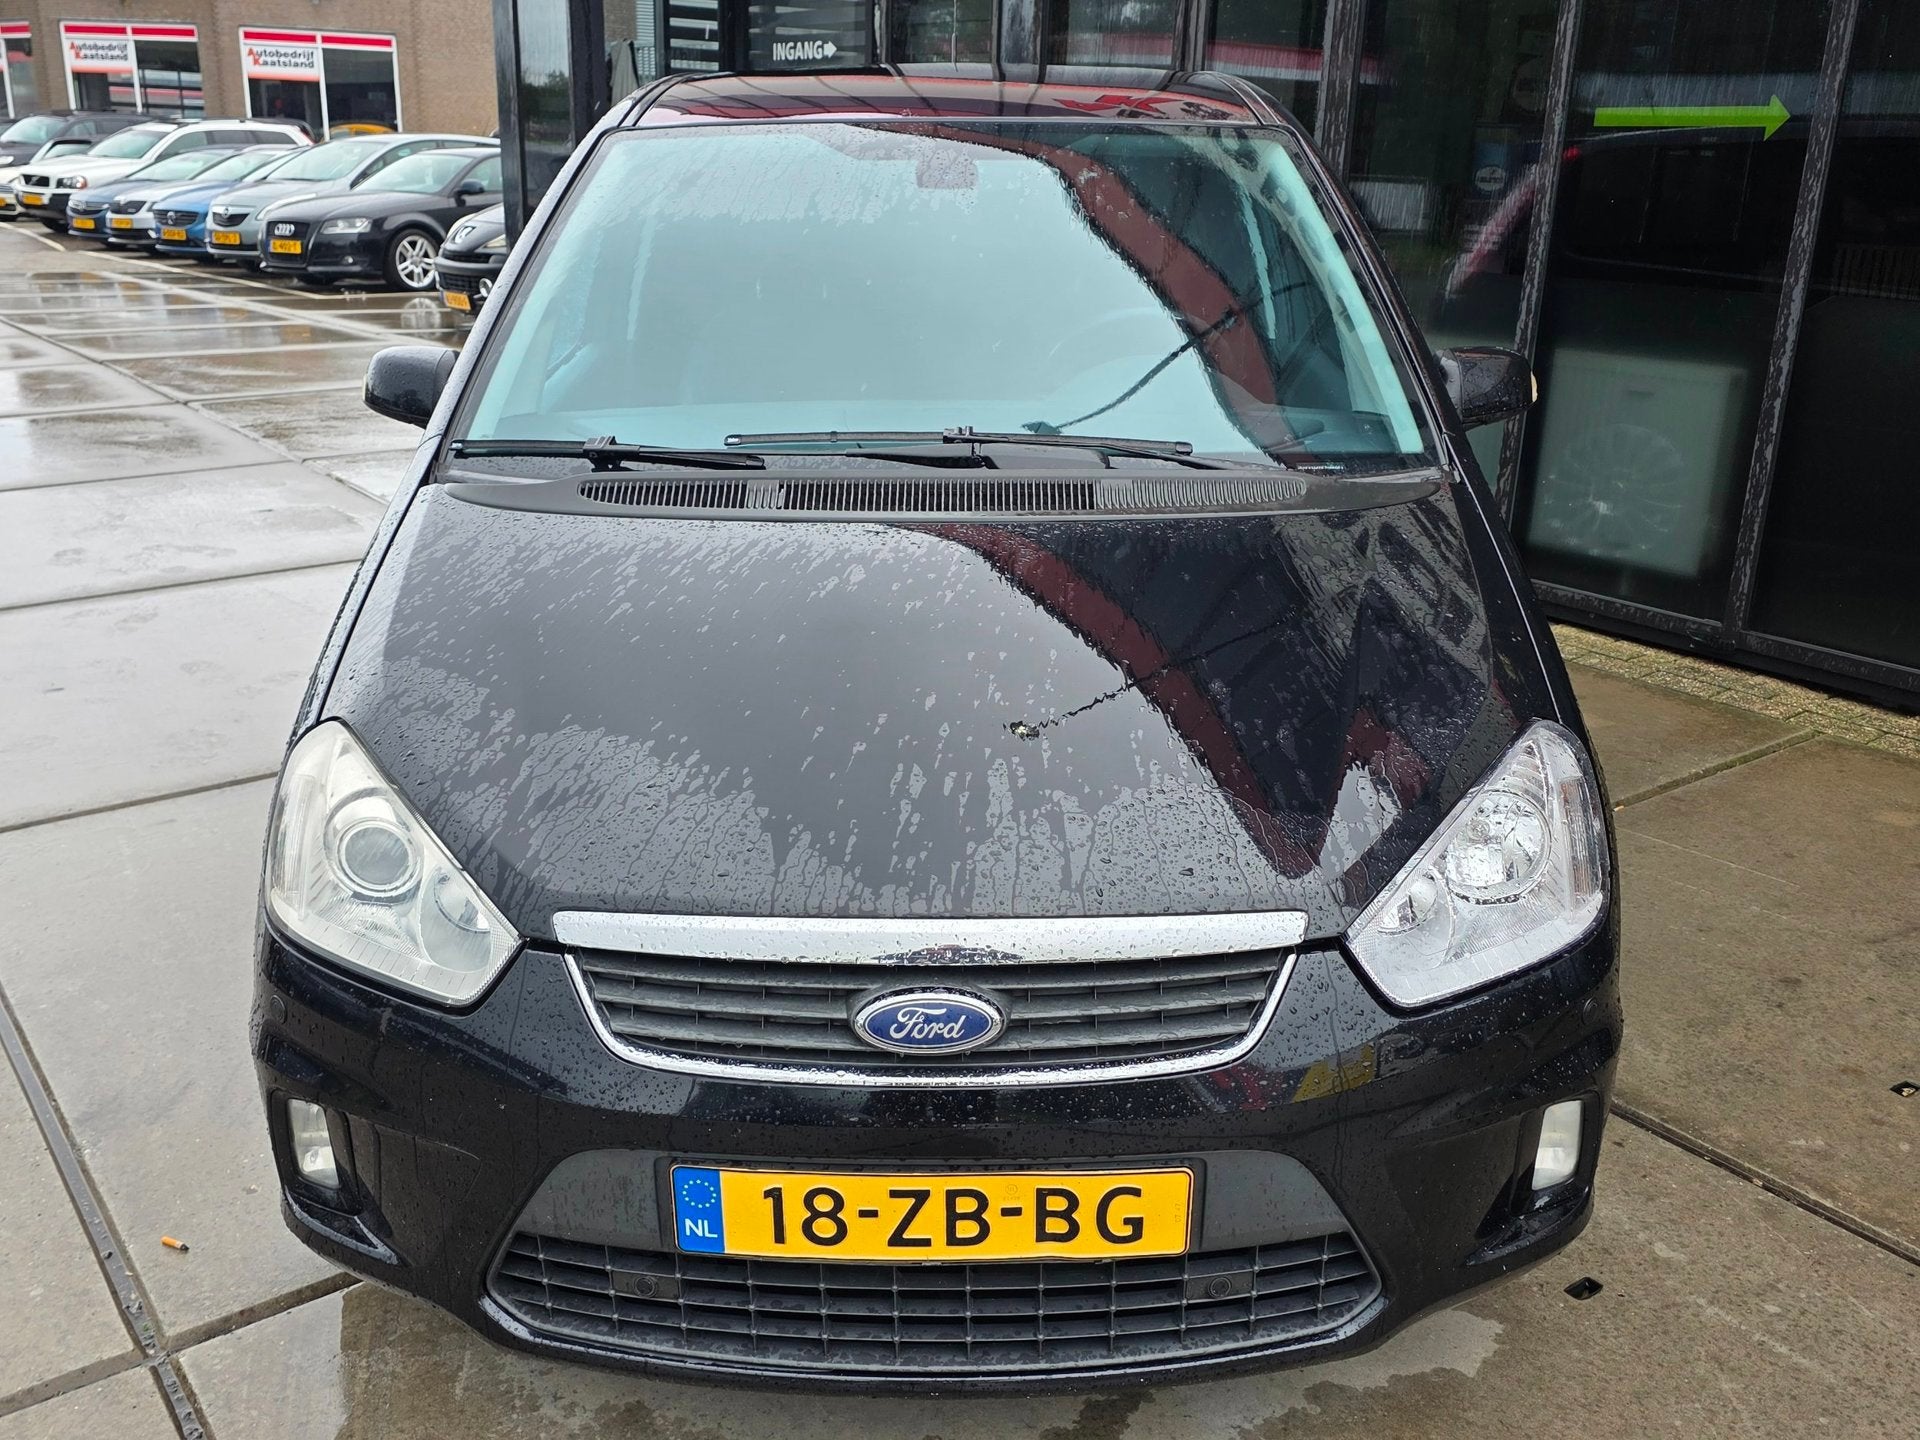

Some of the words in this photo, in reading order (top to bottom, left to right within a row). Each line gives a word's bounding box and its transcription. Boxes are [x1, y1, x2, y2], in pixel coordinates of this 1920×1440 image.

[247, 48, 314, 61] Autobedrijf
[772, 40, 823, 61] INGANG
[253, 55, 315, 68] Kaatsland
[889, 1007, 966, 1039] Ford
[762, 1185, 1145, 1248] 18-ZB-BG
[685, 1218, 718, 1239] NL
